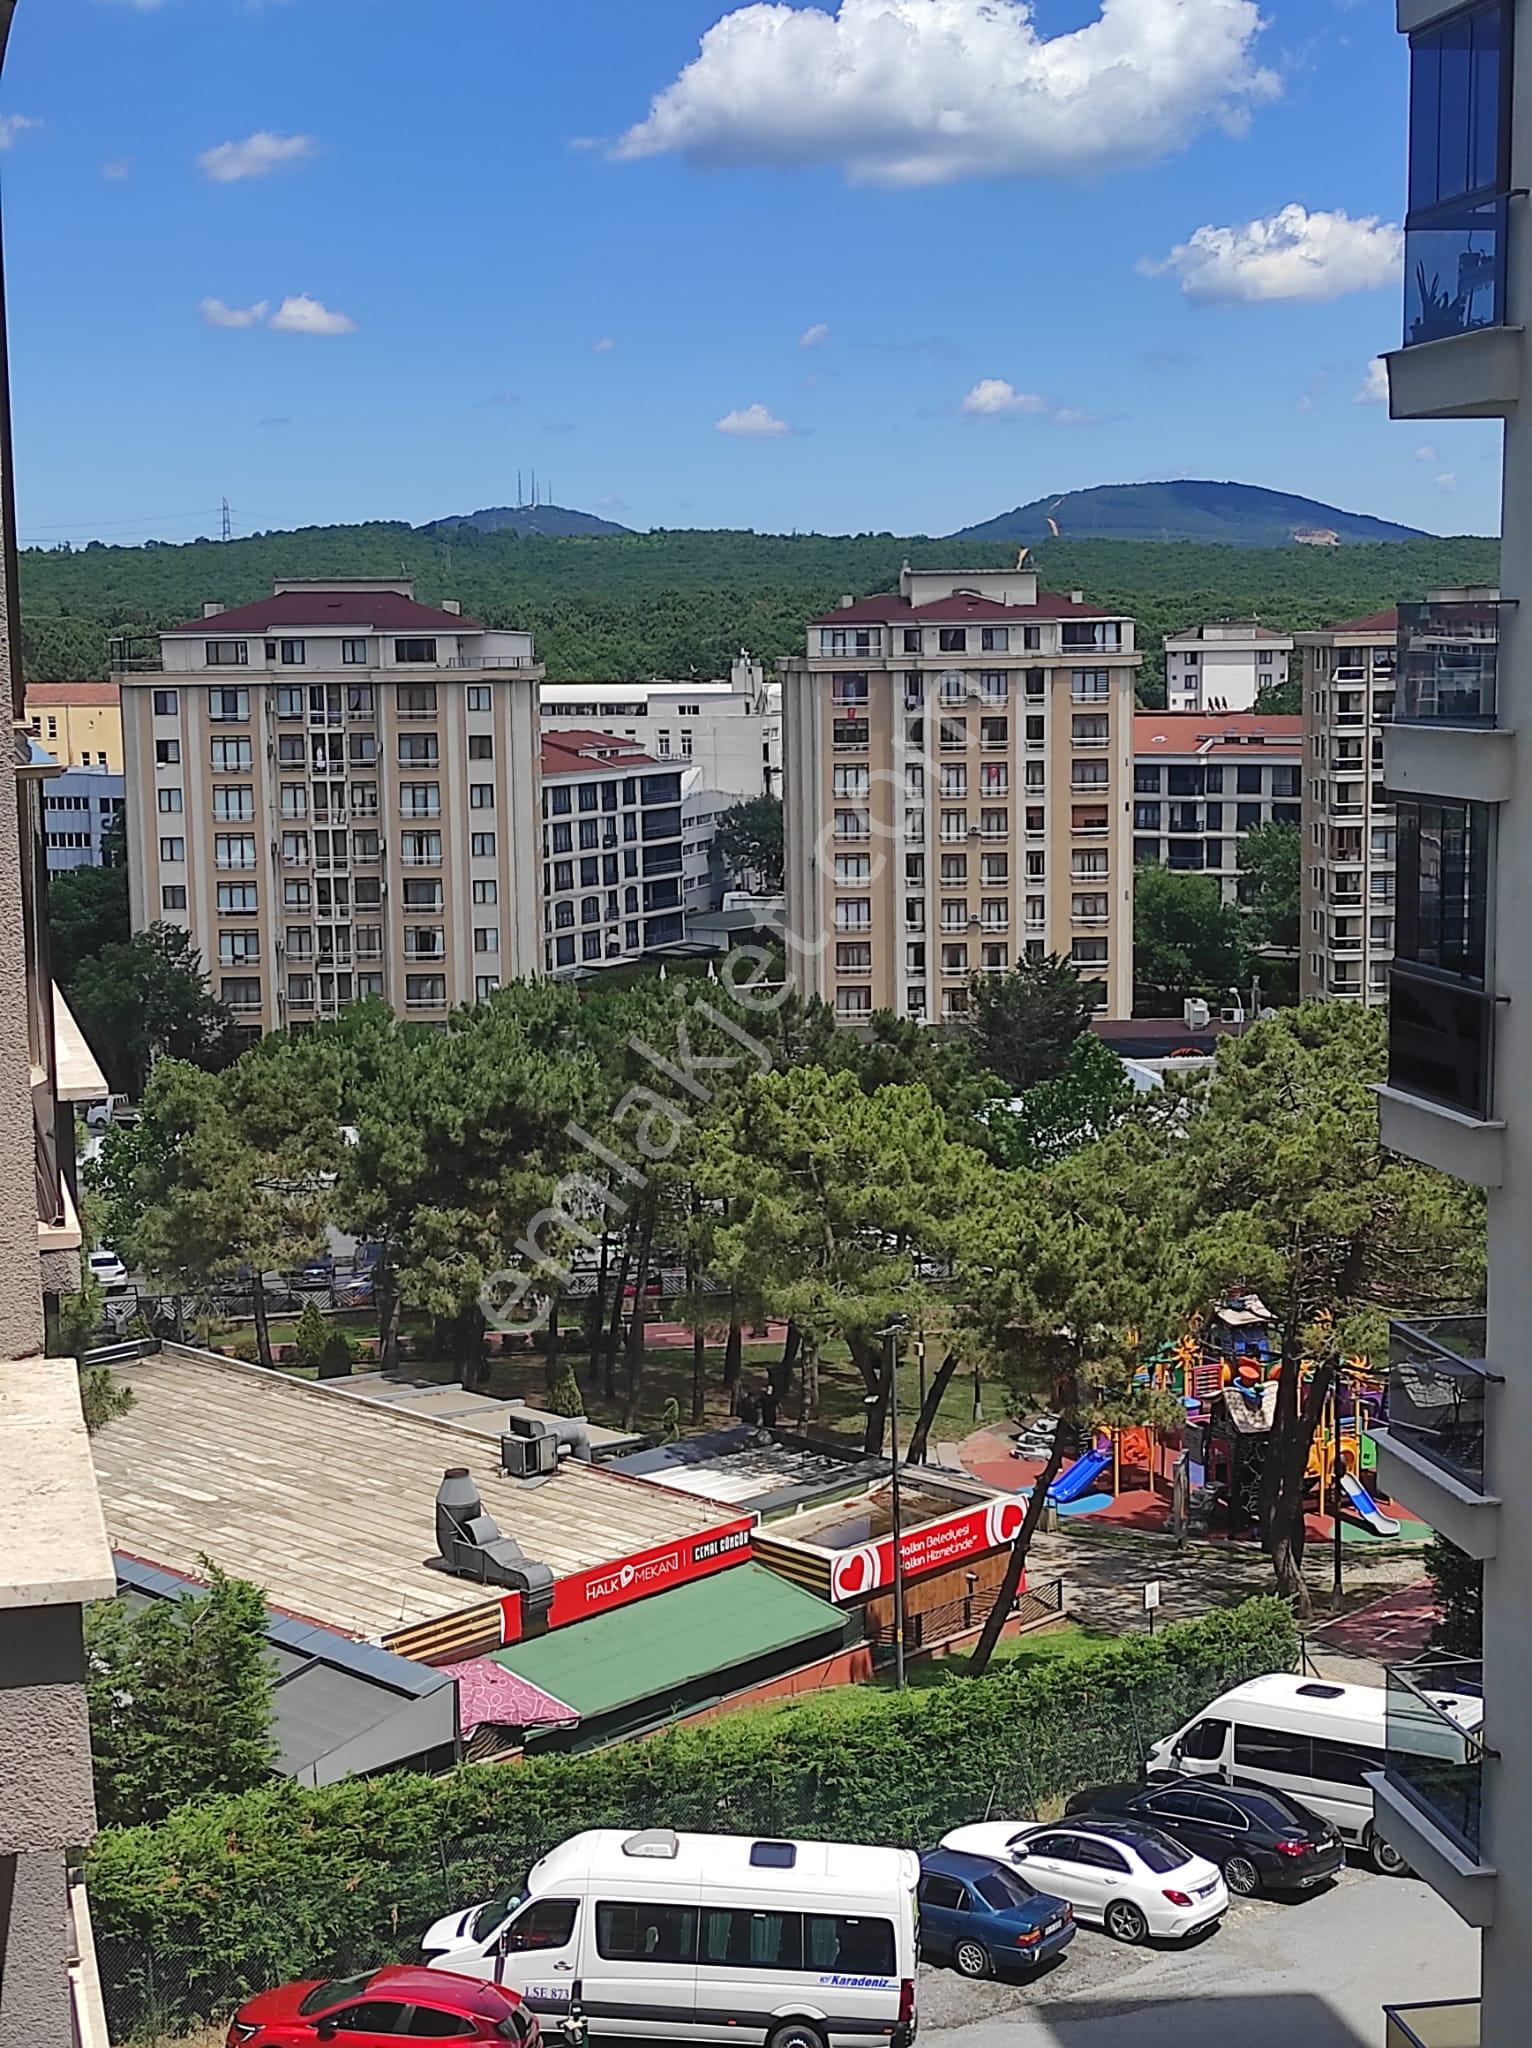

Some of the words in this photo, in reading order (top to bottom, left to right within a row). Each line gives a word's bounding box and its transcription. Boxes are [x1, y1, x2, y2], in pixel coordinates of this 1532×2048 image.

[926, 1523, 970, 1548] Belediyesi
[695, 1541, 719, 1560] CEMAL
[586, 1578, 619, 1602] HALK
[634, 1558, 678, 1585] MEKAN
[831, 1975, 889, 1988] Karadeniz
[551, 1988, 570, 2000] 873
